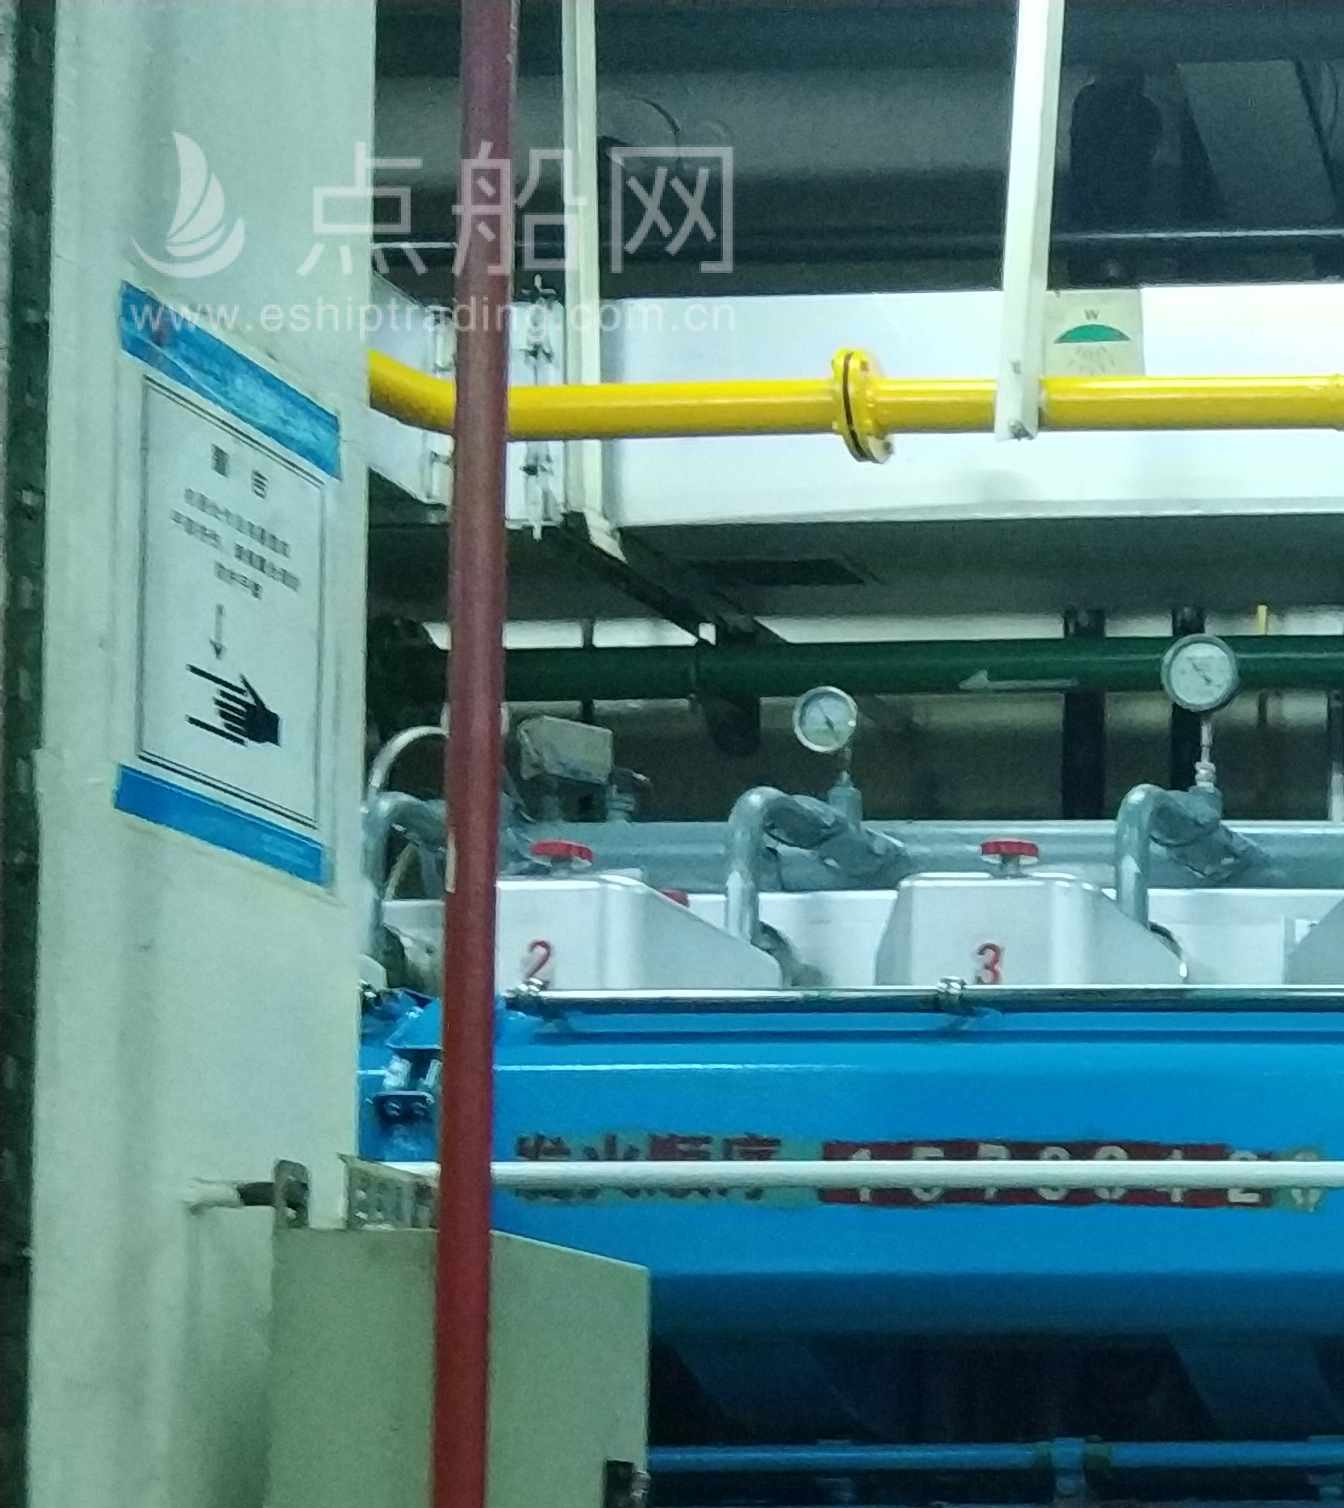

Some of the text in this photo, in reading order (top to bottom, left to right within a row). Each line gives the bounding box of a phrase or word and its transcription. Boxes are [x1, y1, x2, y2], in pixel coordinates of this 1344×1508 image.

[1083, 308, 1100, 321] W
[527, 939, 552, 978] 2
[974, 943, 1002, 984] 3
